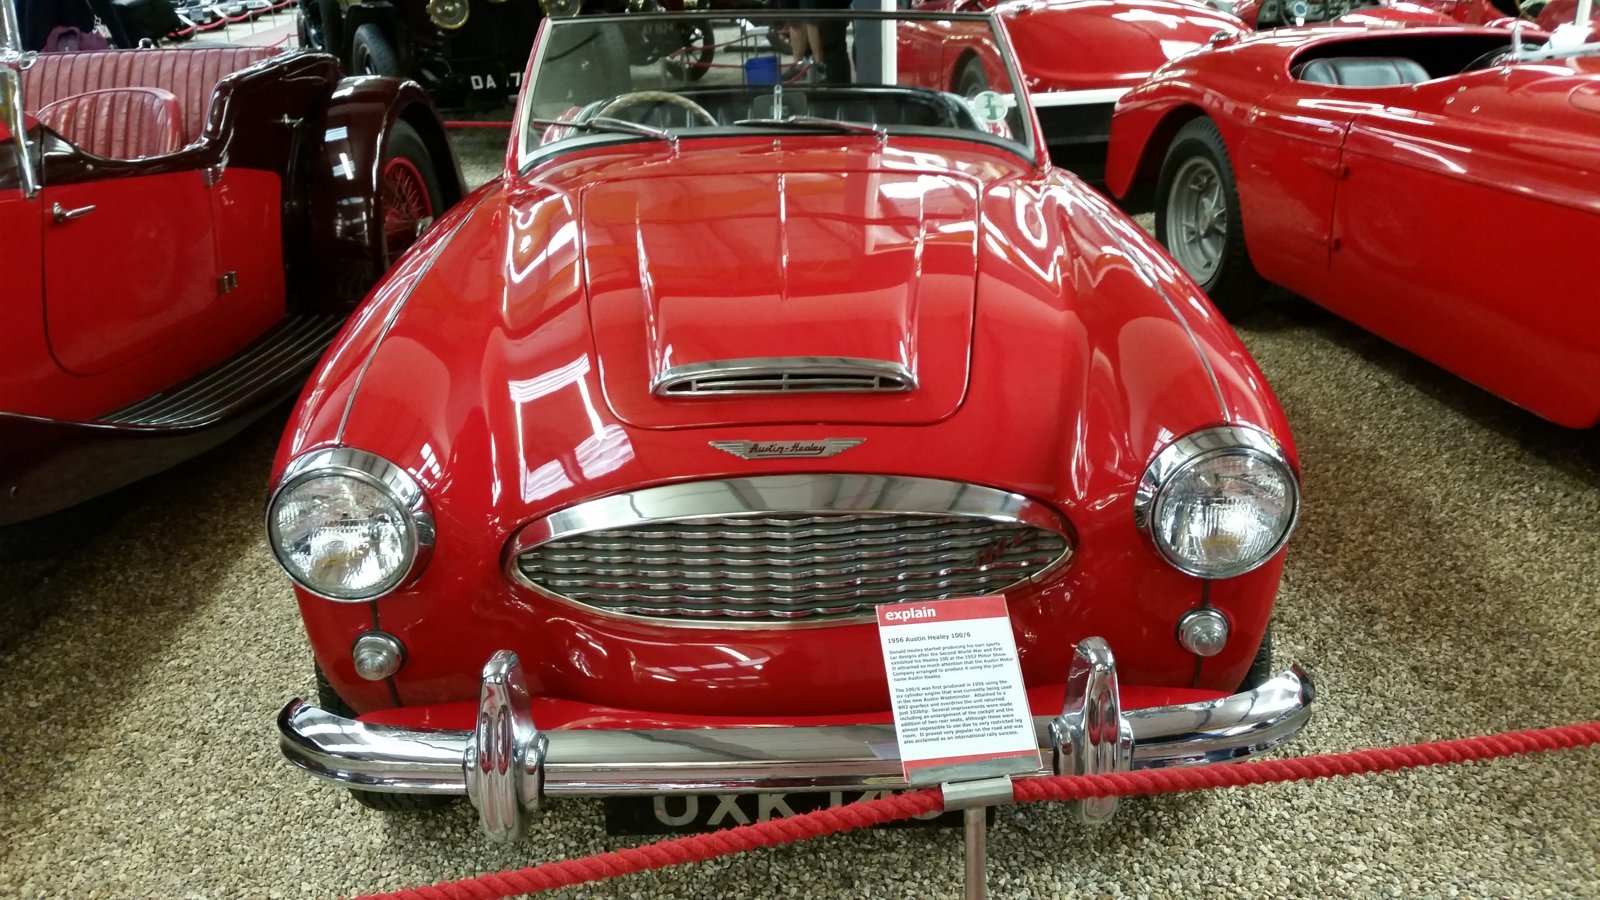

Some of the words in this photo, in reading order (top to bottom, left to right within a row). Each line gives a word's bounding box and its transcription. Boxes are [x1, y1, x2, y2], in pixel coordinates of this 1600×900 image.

[470, 73, 497, 90] DA
[749, 443, 826, 455] Austin-Healey
[885, 606, 936, 622] explain
